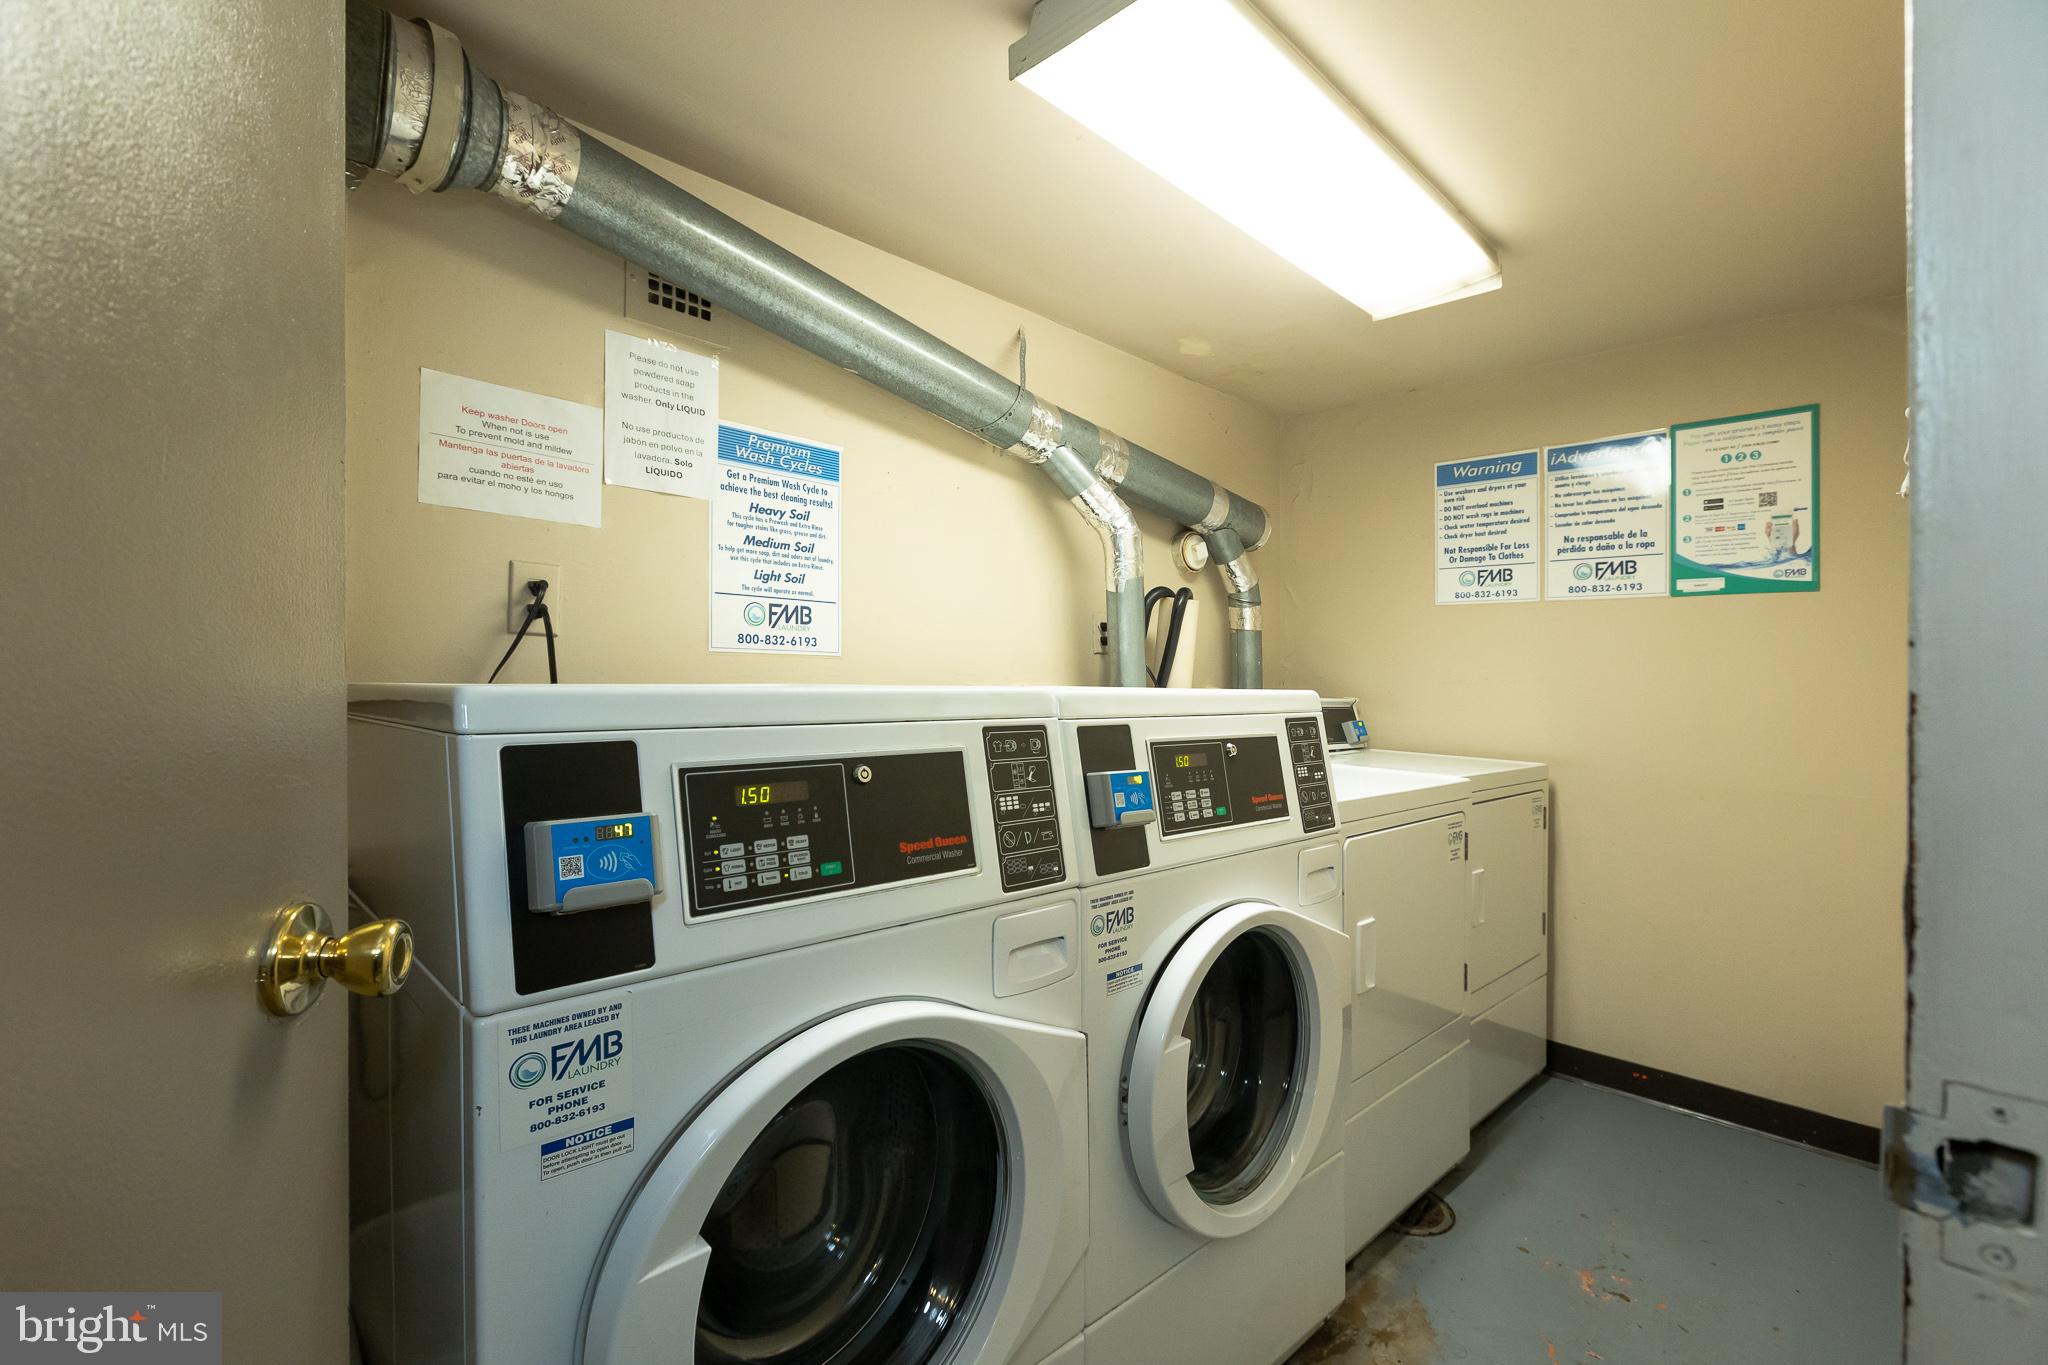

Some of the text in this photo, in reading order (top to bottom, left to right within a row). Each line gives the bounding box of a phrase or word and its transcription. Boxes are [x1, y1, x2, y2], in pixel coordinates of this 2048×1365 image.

[629, 352, 656, 365] Please
[670, 363, 683, 372] not
[634, 368, 695, 389] powdered soap
[634, 381, 670, 395] products
[682, 392, 694, 401] the
[655, 400, 674, 411] Only
[676, 404, 705, 416] LIQUID
[461, 405, 568, 435] Keep washer Doors open
[482, 420, 507, 432] When
[510, 426, 523, 436] not
[535, 432, 550, 440] use
[622, 422, 634, 430] No
[653, 428, 693, 443] productos
[456, 426, 572, 455] To prevent mold and mildew
[748, 435, 810, 459] Premium
[439, 439, 483, 455] Mantenga
[486, 448, 498, 456] las
[501, 452, 532, 464] puertas
[557, 462, 589, 473] lavadora
[661, 444, 683, 454] polvo
[696, 449, 702, 457] la
[736, 445, 823, 474] Wash Cycles
[468, 466, 500, 478] cuando
[501, 462, 534, 473] abiertas
[1453, 461, 1522, 478] Warning
[437, 472, 458, 481] para
[461, 475, 485, 485] evitar
[498, 482, 521, 491] moho
[545, 489, 574, 500] hongos
[727, 469, 739, 479] Get
[750, 474, 779, 488] Premium
[782, 480, 800, 490] Wash
[803, 484, 819, 495] Cycle
[720, 483, 832, 508] achieve the best cleaning results!
[749, 502, 810, 521] Heavy Soil
[743, 535, 815, 553] Medium Soil
[1577, 531, 1624, 543] responsable
[1628, 530, 1637, 538] de
[1636, 541, 1655, 549] ropa
[1459, 544, 1498, 554] Responsible
[1460, 555, 1486, 563] Damage
[754, 570, 805, 584] Light Soil
[1477, 569, 1513, 587] FMB
[1595, 560, 1637, 580] FMB
[1785, 568, 1807, 577] FMB
[1455, 590, 1518, 599] 800-832-6193
[1568, 583, 1642, 593] 800-832-6193
[769, 603, 812, 628] FMB
[738, 634, 817, 646] 800-832-6193
[741, 786, 770, 805] 1.50
[615, 823, 632, 836] 47
[899, 835, 968, 854] Speed Queen
[907, 849, 963, 864] Commercial Washer
[1106, 907, 1134, 934] FMB
[1105, 945, 1120, 954] PHONE
[1108, 936, 1127, 946] SERVICE
[1116, 967, 1134, 977] NOTICE
[508, 1027, 530, 1036] THESE
[533, 1016, 569, 1029] MACHINES
[572, 1008, 596, 1020] OWNED
[609, 1003, 622, 1012] AND
[511, 1036, 527, 1045] THIS
[529, 1027, 561, 1042] LAUNDRY
[564, 1022, 582, 1032] AREA
[584, 1015, 609, 1028] LEASED
[551, 1030, 623, 1081] FMB
[568, 1056, 621, 1080] LAUNDRY
[529, 1080, 606, 1109] FOR SERVICE
[548, 1096, 588, 1115] PHONE
[530, 1102, 606, 1133] 800-832-6193
[566, 1125, 612, 1148] NOTICE
